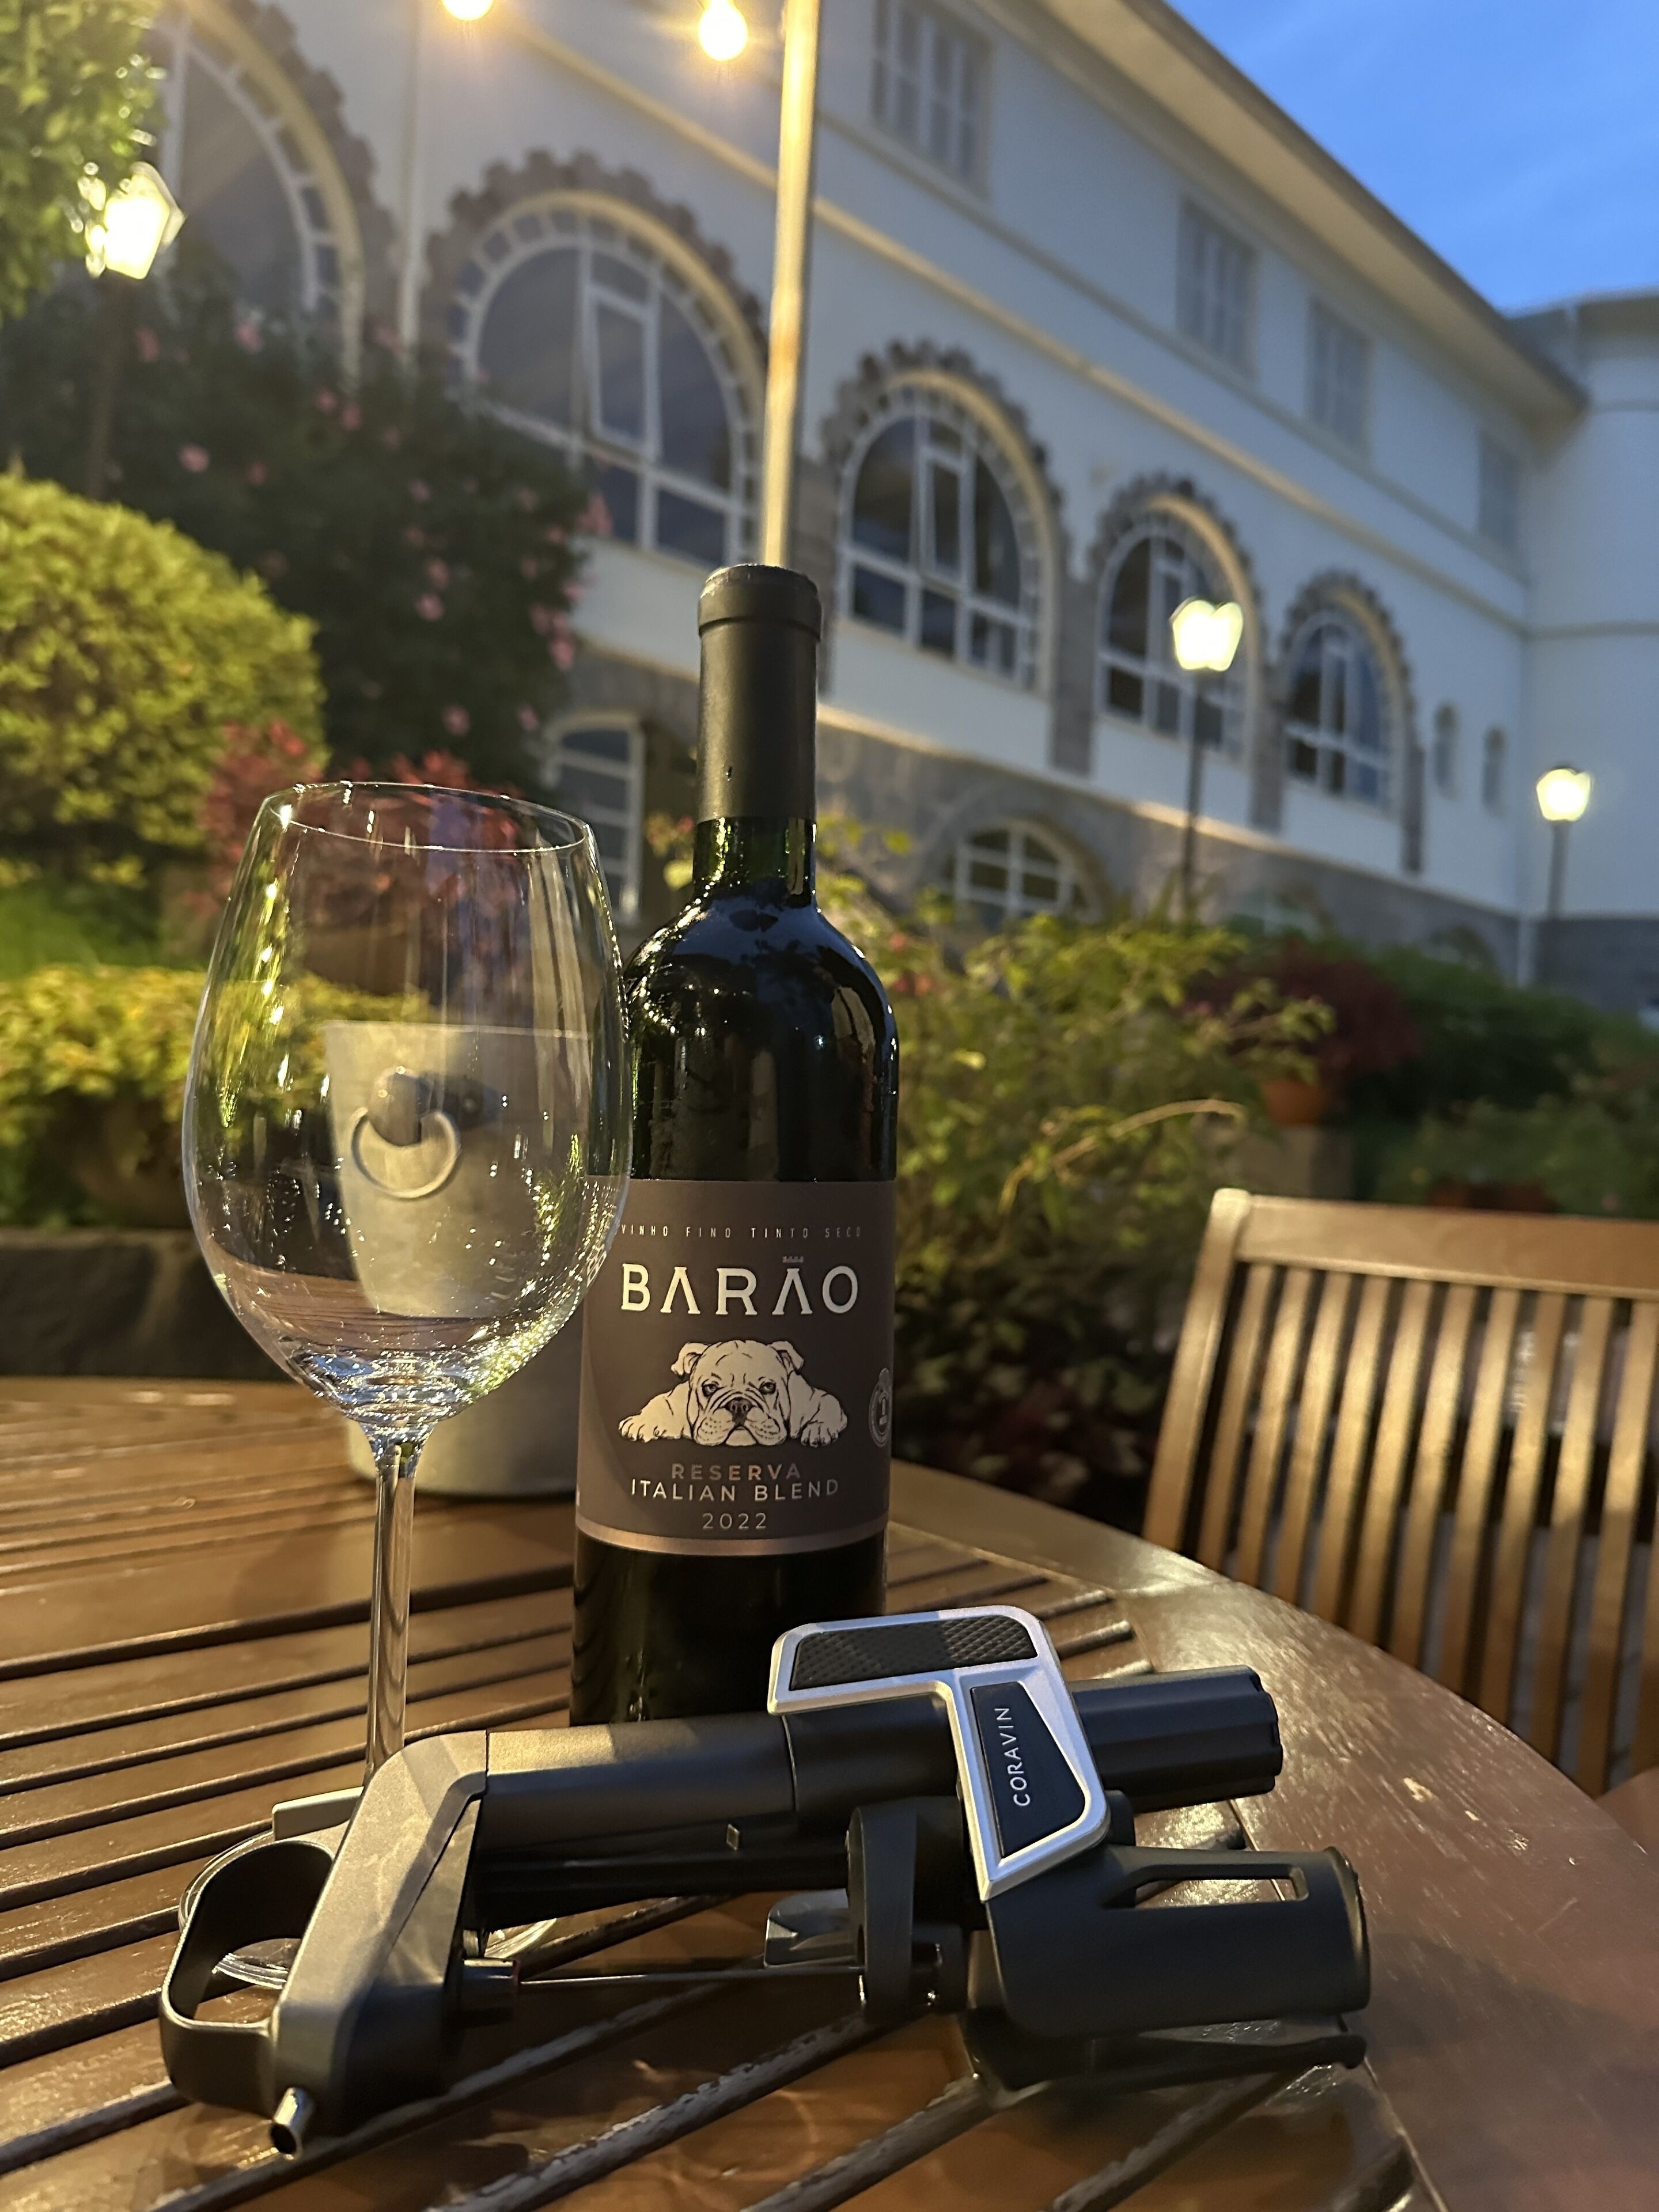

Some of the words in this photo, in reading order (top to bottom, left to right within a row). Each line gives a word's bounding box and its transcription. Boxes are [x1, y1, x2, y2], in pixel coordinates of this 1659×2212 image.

[621, 1224, 669, 1237] VINHO
[685, 1226, 731, 1238] FINO
[751, 1227, 809, 1238] TINTO
[824, 1226, 862, 1238] SECO
[672, 1463, 801, 1481] RESERVA
[631, 1479, 736, 1501] ITALIAN
[754, 1479, 839, 1501] BLEND
[702, 1513, 767, 1530] 2022
[994, 1707, 1031, 1807] CORAVIN
